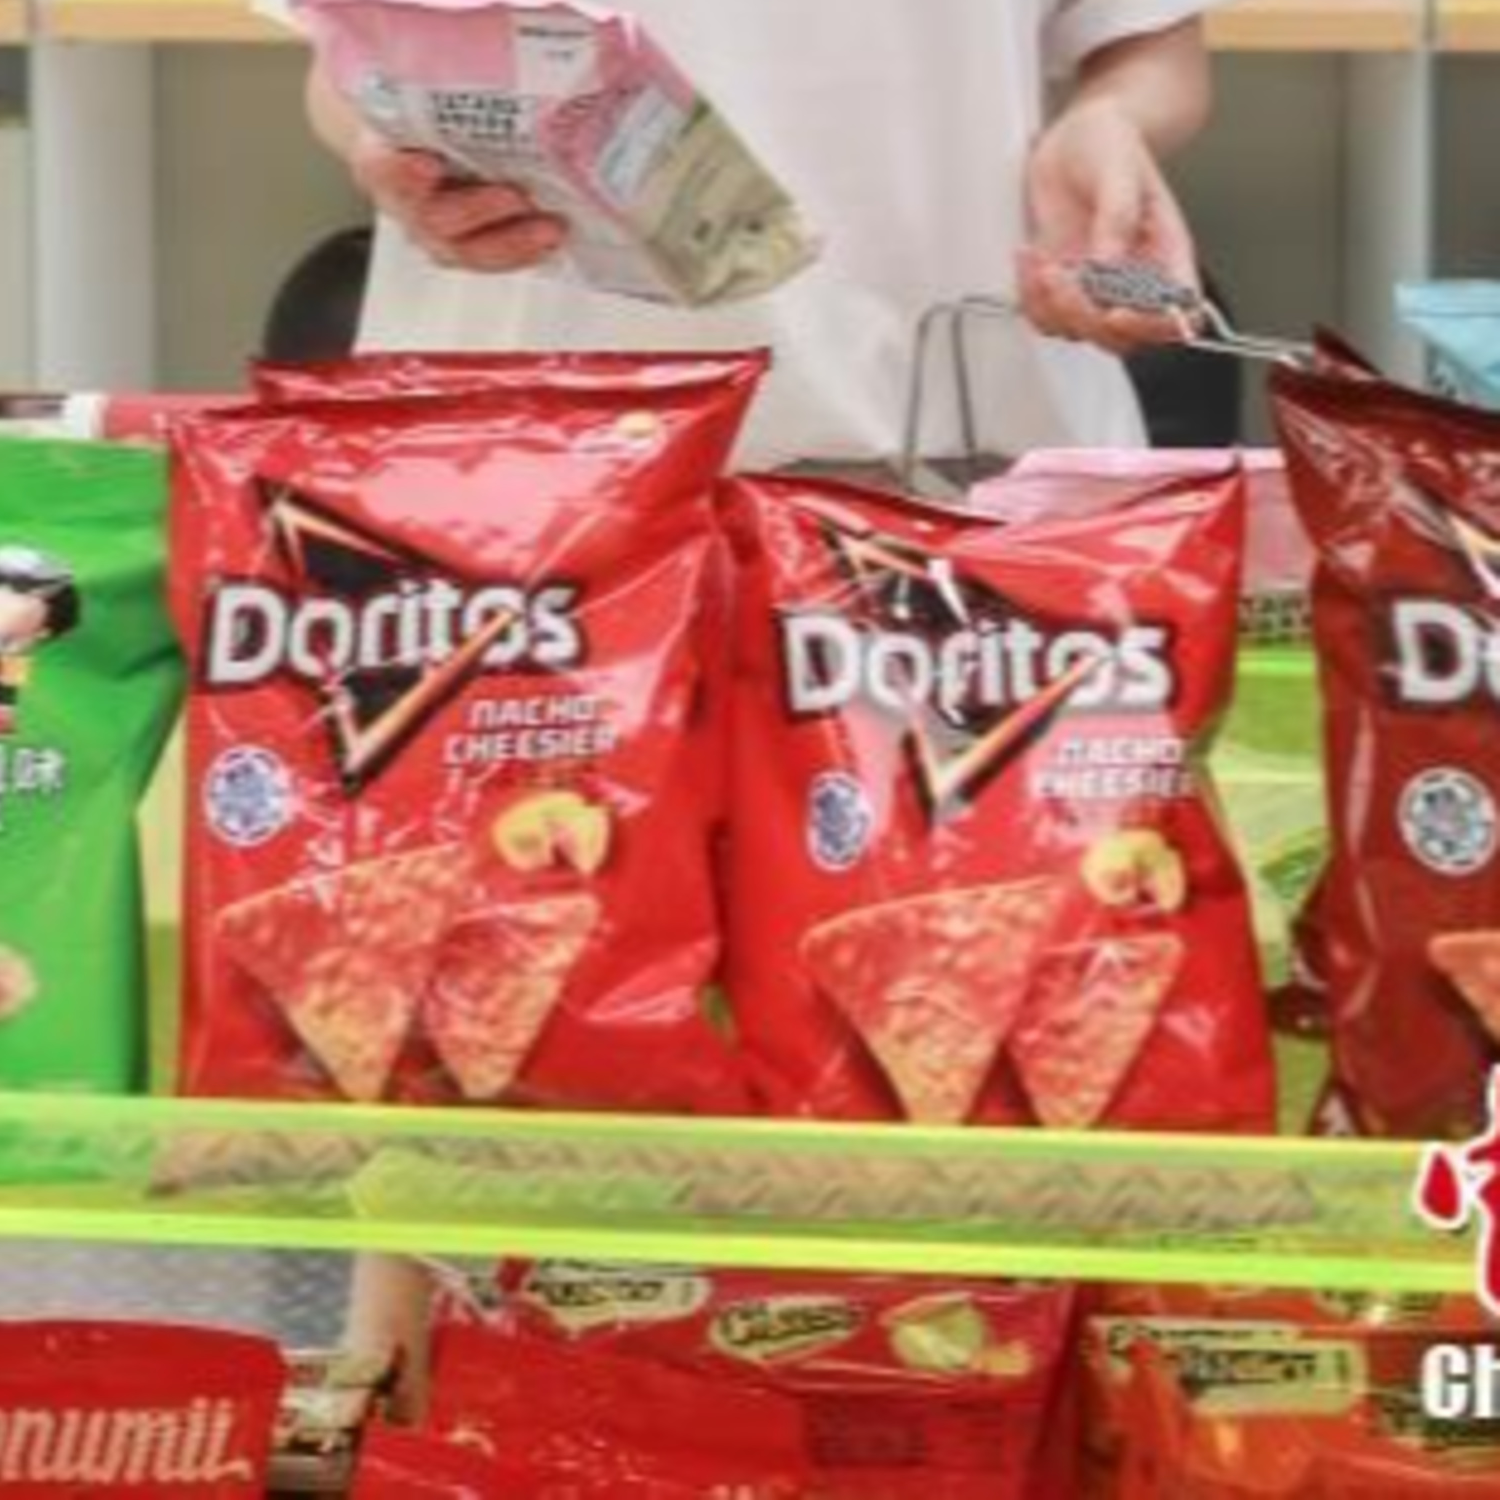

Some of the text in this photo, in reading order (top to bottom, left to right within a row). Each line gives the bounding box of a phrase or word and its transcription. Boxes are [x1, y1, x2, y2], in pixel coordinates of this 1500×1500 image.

[206, 577, 583, 687] Doritos
[781, 606, 1174, 713] Doritos
[470, 692, 601, 731] NACHO
